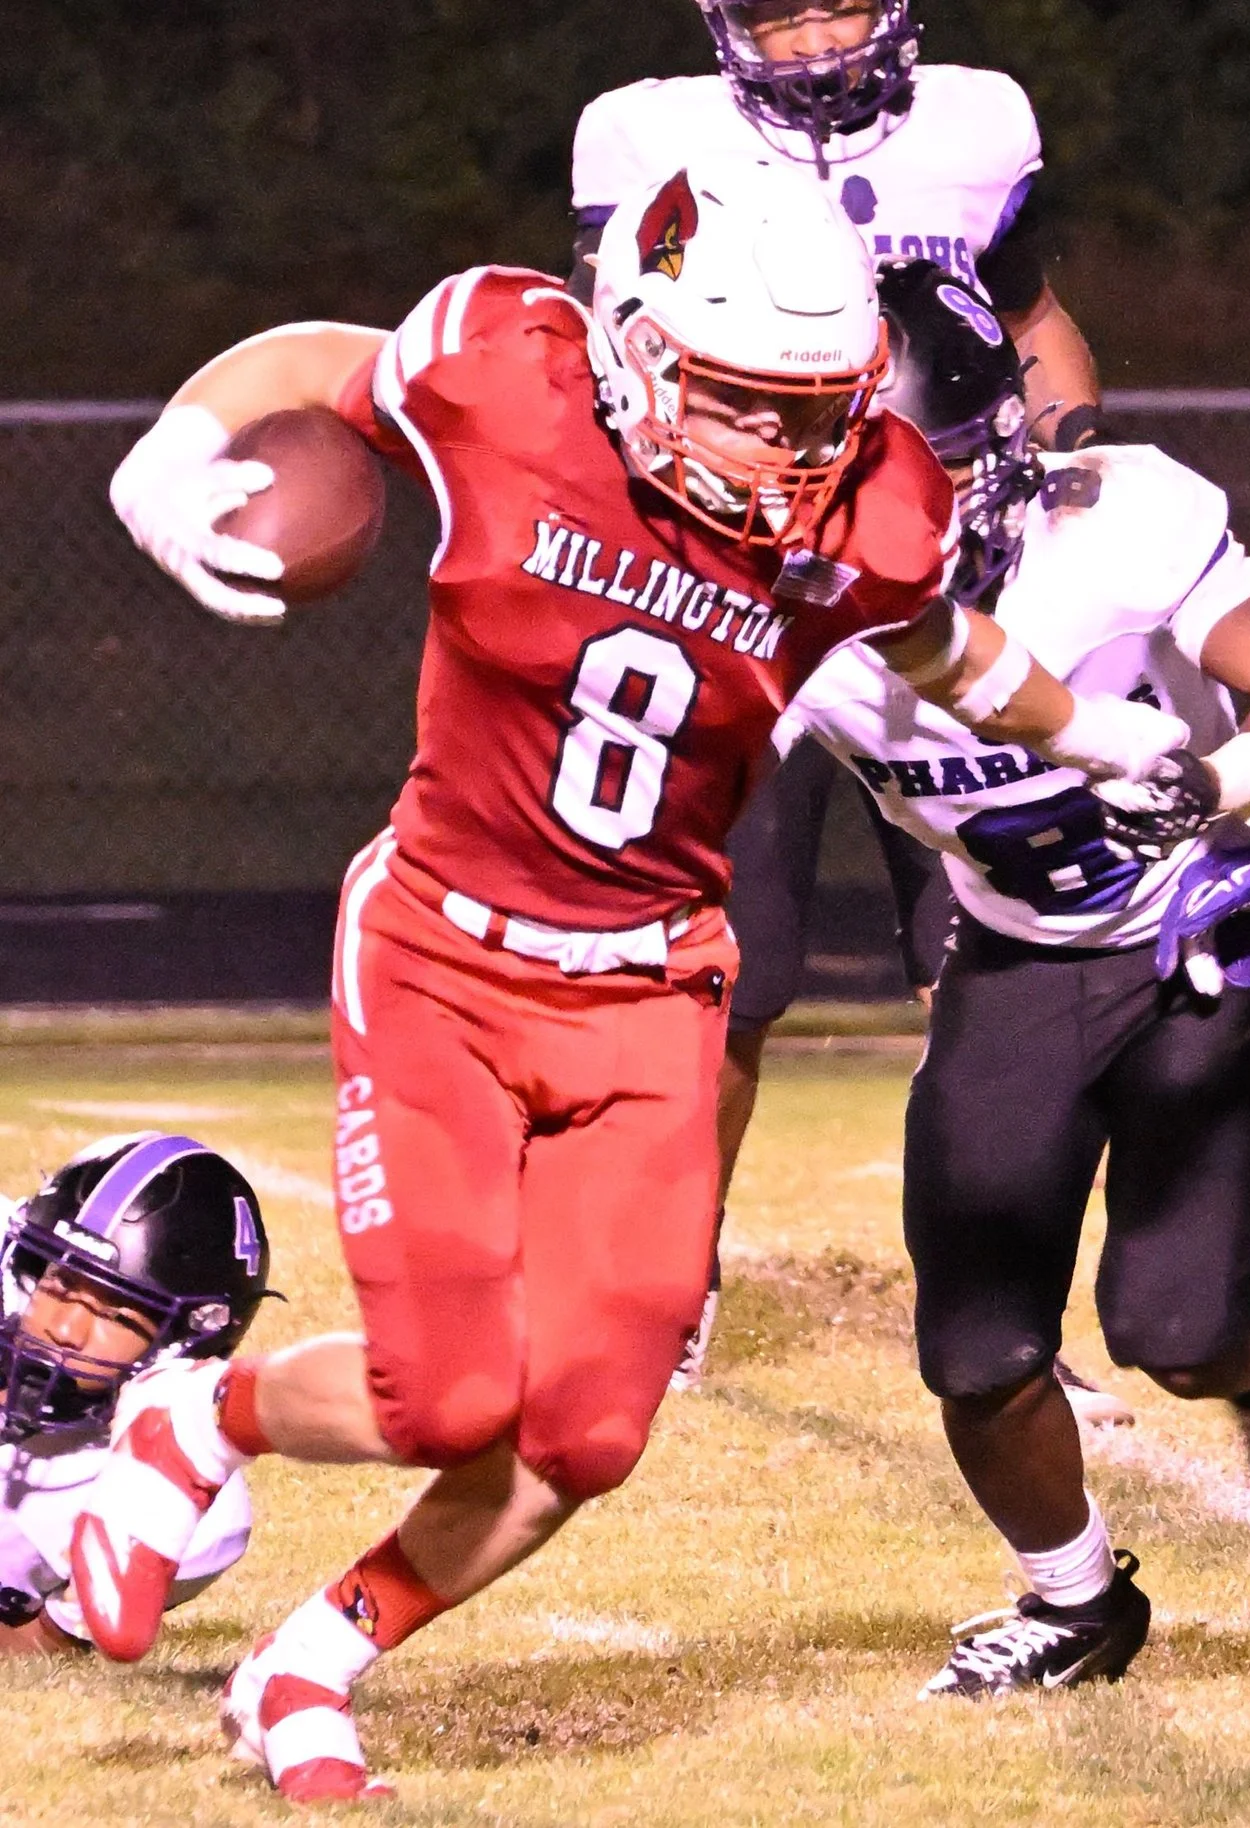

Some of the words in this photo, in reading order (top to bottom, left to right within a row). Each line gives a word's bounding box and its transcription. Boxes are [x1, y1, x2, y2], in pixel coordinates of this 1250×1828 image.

[936, 283, 1003, 346] 8
[520, 517, 796, 662] MILLINGTON
[548, 620, 704, 853] 8
[335, 1074, 394, 1235] CARDS
[233, 1196, 261, 1277] 4
